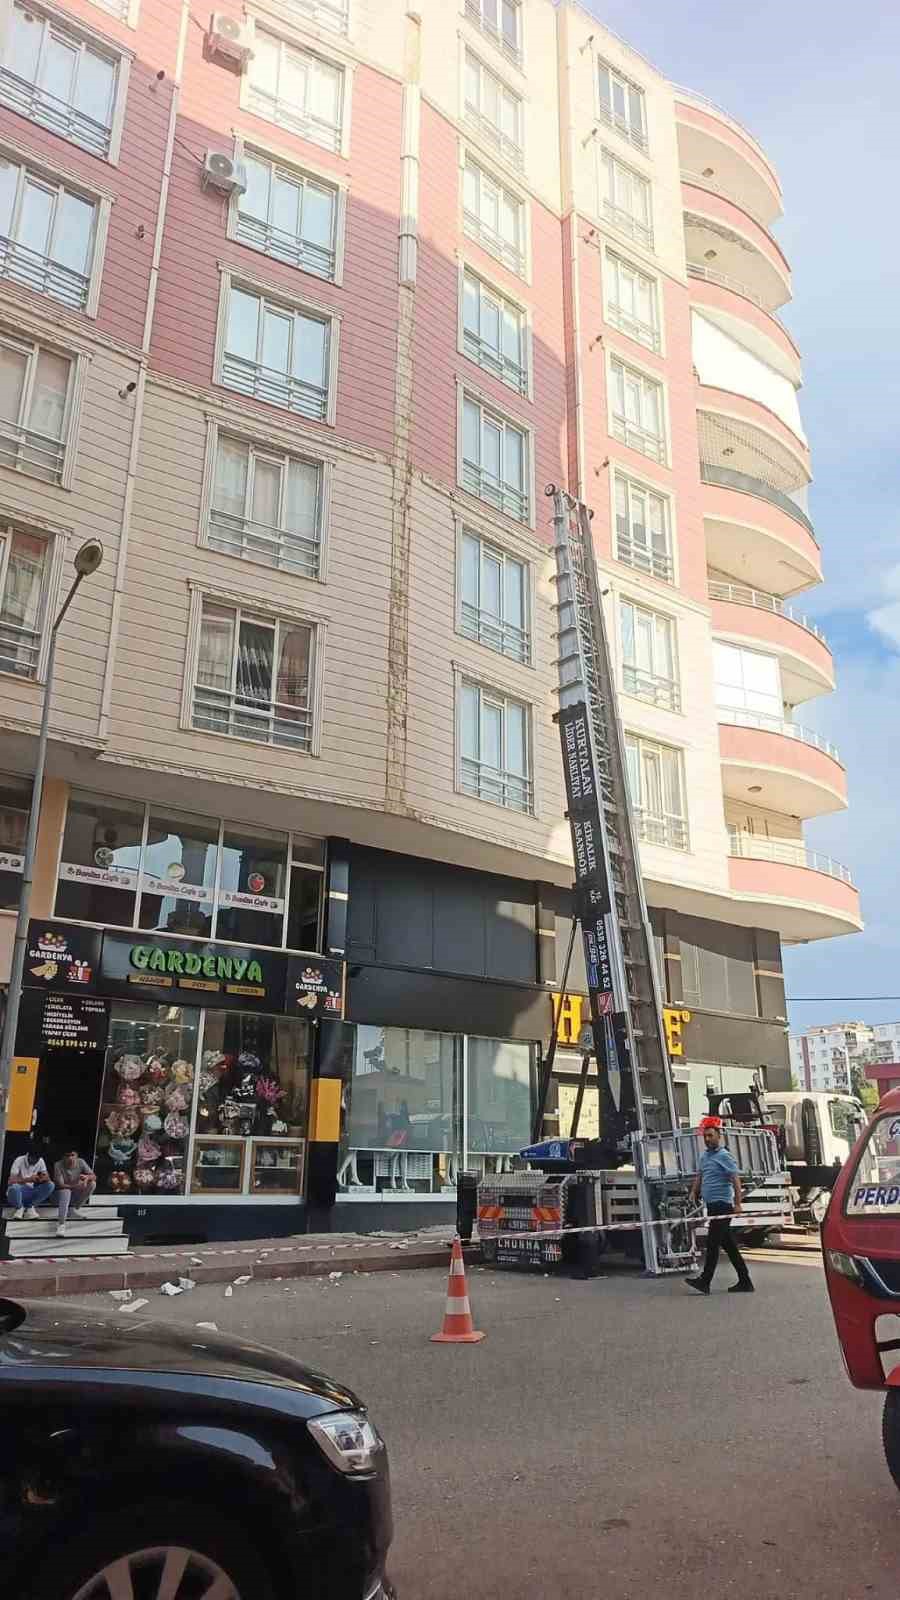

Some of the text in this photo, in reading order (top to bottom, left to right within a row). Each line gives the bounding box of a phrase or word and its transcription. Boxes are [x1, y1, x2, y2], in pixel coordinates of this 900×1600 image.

[576, 718, 592, 796] KURTALAN
[29, 950, 73, 961] GARDENYA
[130, 944, 262, 983] GARDENYA
[295, 982, 328, 992] GARDENYA
[603, 977, 610, 989] 52
[854, 1187, 900, 1206] PERD
